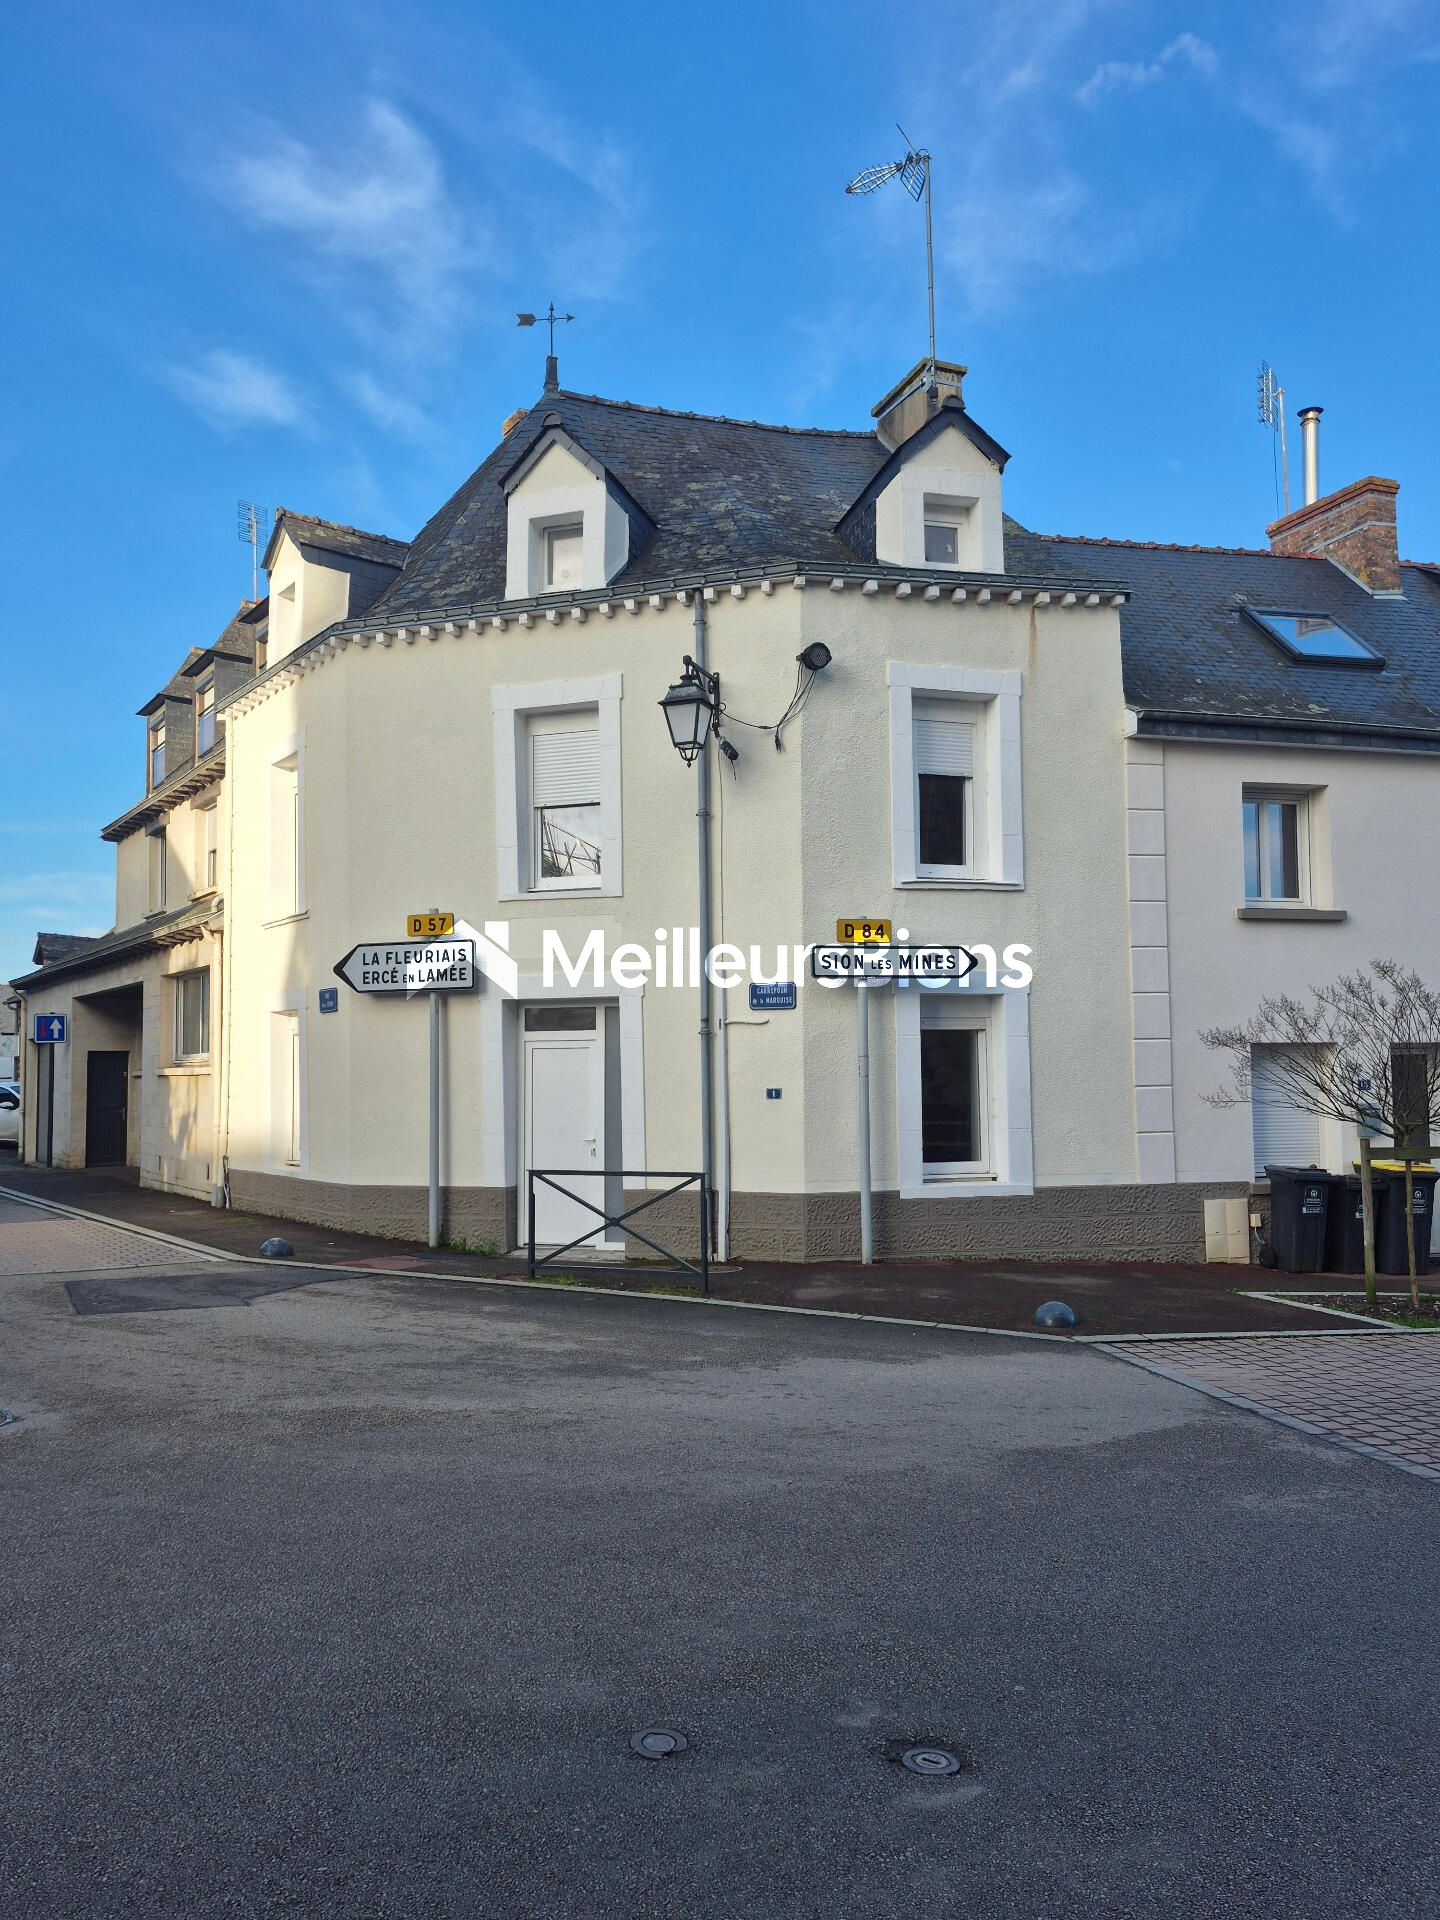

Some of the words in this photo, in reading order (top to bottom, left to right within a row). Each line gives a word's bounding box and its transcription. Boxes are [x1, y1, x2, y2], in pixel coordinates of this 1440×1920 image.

[413, 919, 422, 933] D
[428, 917, 447, 932] 57
[844, 924, 854, 939] D
[862, 924, 885, 939] 84
[362, 951, 380, 966] LA
[385, 948, 467, 965] FLEURIAIS
[821, 954, 864, 970] SION
[871, 959, 892, 970] LES
[899, 954, 956, 970] MINES
[362, 967, 399, 985] ERCÉ
[418, 965, 467, 983] LAMÉE
[756, 987, 788, 995] CARREFOUR
